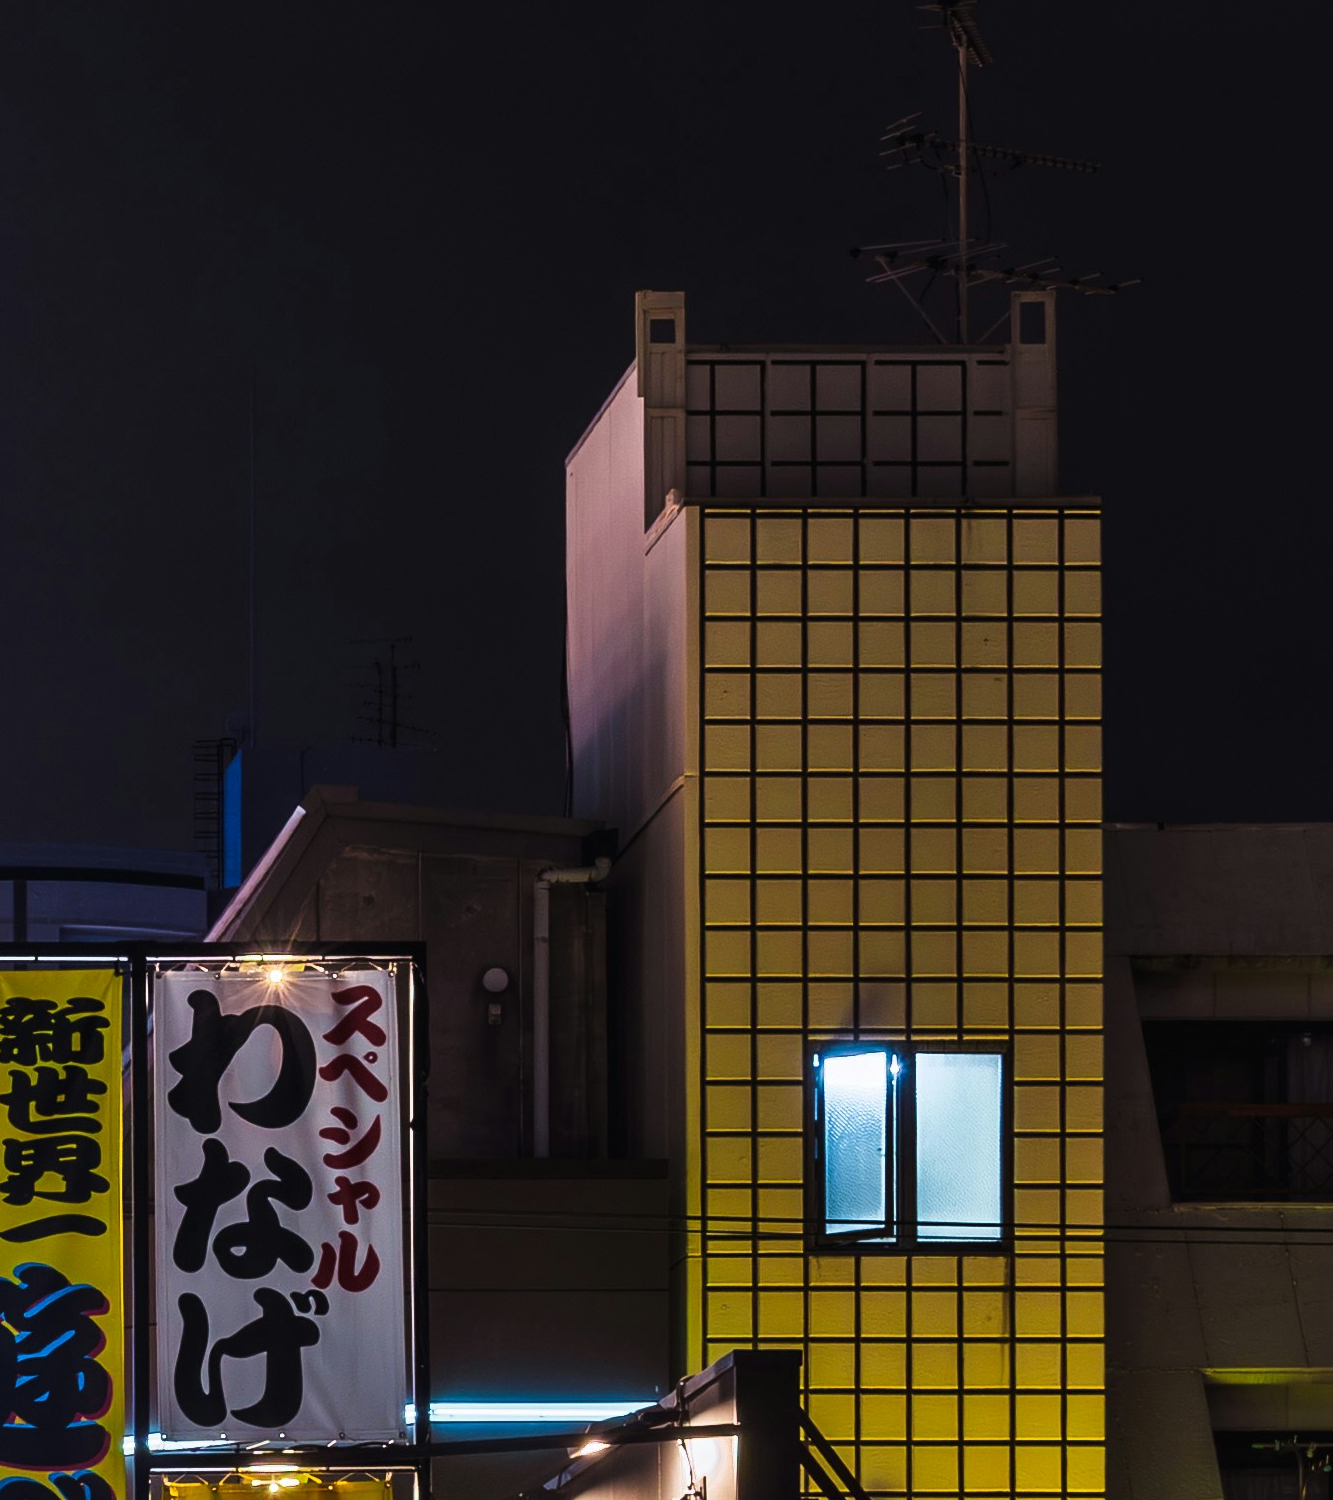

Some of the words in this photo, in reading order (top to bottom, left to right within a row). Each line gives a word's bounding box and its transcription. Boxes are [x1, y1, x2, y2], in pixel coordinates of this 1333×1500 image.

[168, 989, 329, 1428] わなげ
[312, 985, 388, 1292] スペシャル
